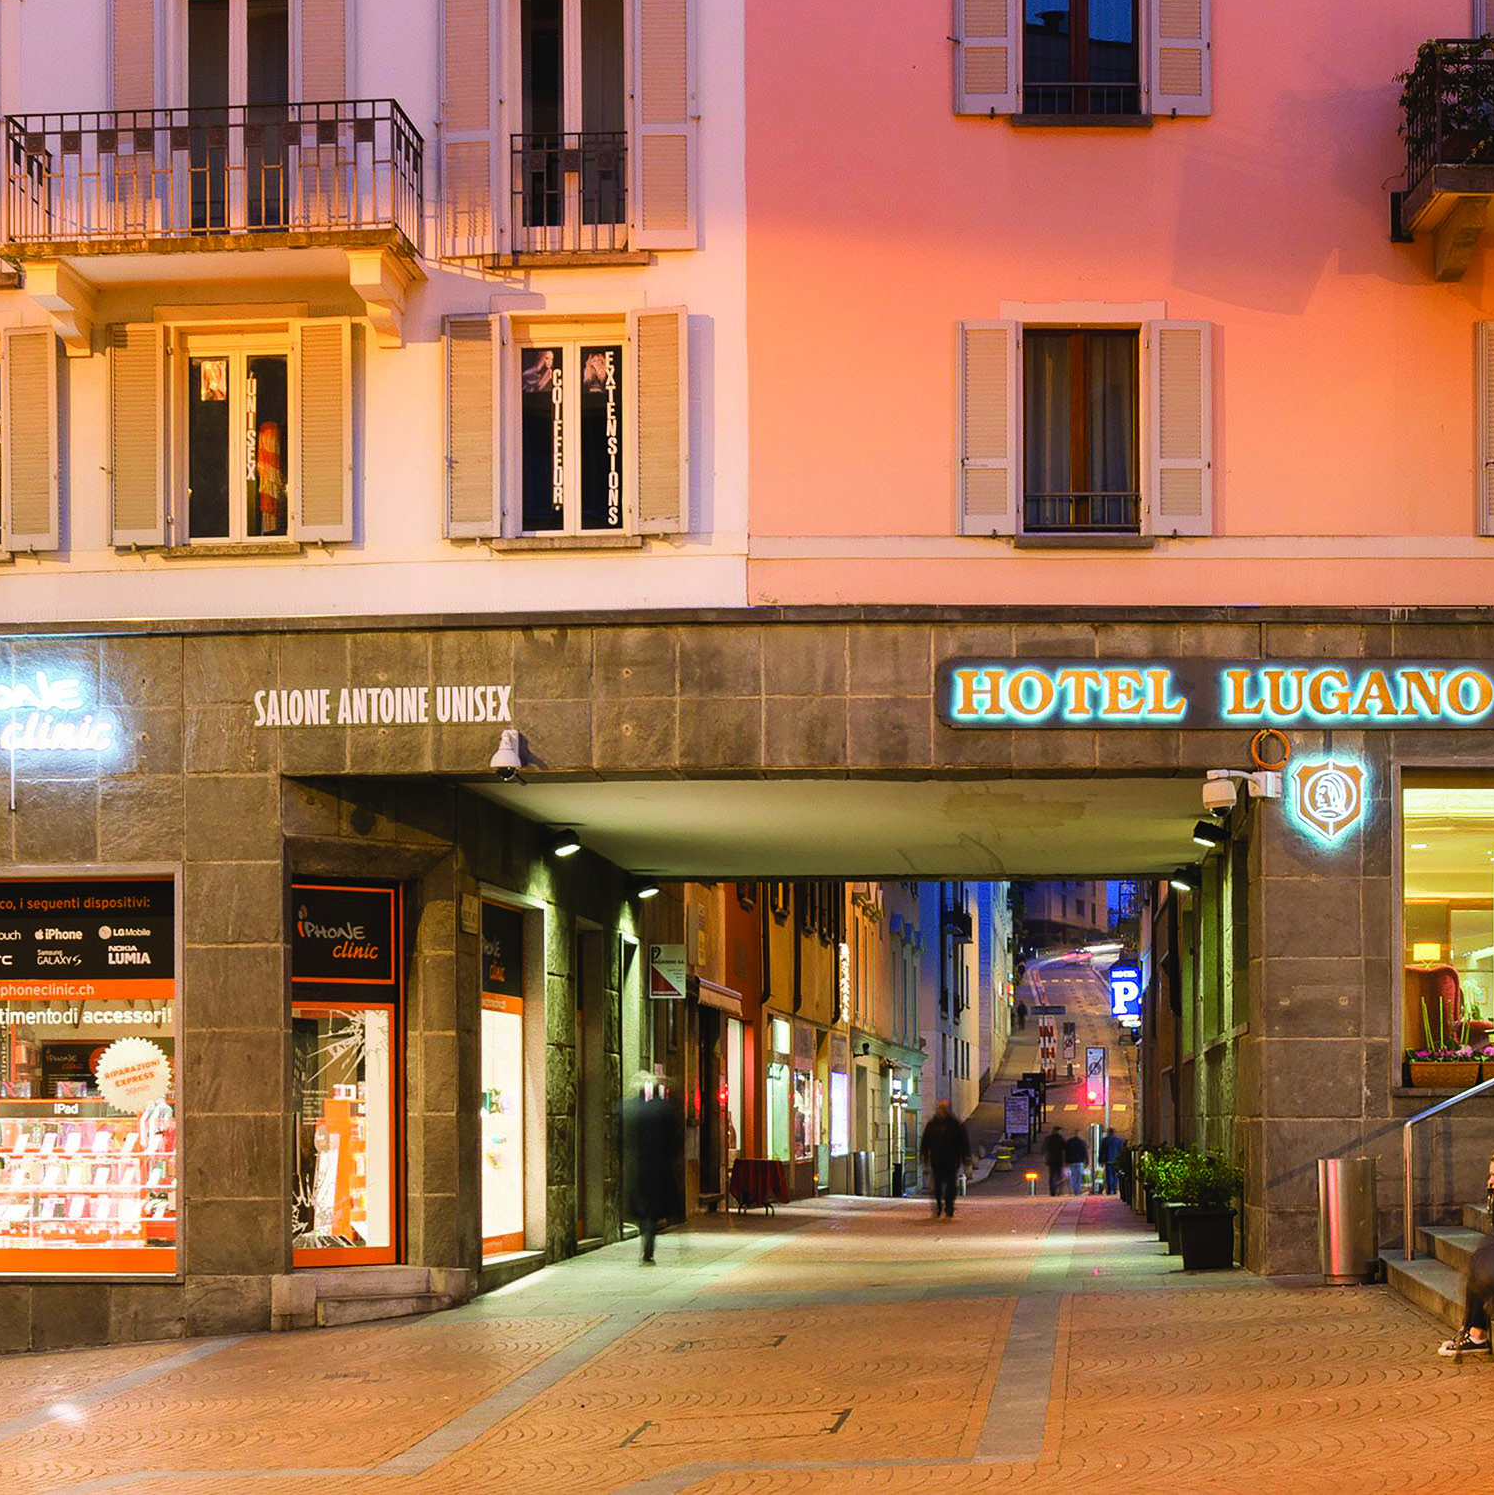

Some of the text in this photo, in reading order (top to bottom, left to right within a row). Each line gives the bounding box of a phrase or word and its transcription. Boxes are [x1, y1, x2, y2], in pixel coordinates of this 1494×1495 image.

[245, 377, 257, 482] UNISEX
[552, 368, 563, 505] COIFFEUR
[604, 350, 620, 525] EXTENSIONS
[956, 669, 1188, 715] HOTEL
[1226, 669, 1494, 715] LUGANO
[254, 685, 512, 727] SALONE ANTOINE UNISEX
[0, 712, 112, 751] clinic
[19, 897, 24, 909] i
[26, 896, 80, 912] seguenti
[83, 895, 151, 911] dispositivi:
[45, 928, 84, 941] iPhone
[113, 928, 151, 937] LG Mobile
[108, 952, 152, 965] LUMIA
[332, 940, 379, 960] clinic
[36, 955, 72, 966] GALAXY
[1111, 981, 1139, 1014] P
[82, 1006, 173, 1025] accessori!
[104, 1058, 161, 1080] RIPARAZIONI
[115, 1070, 155, 1087] EXPRESS
[53, 1103, 79, 1115] iPad
